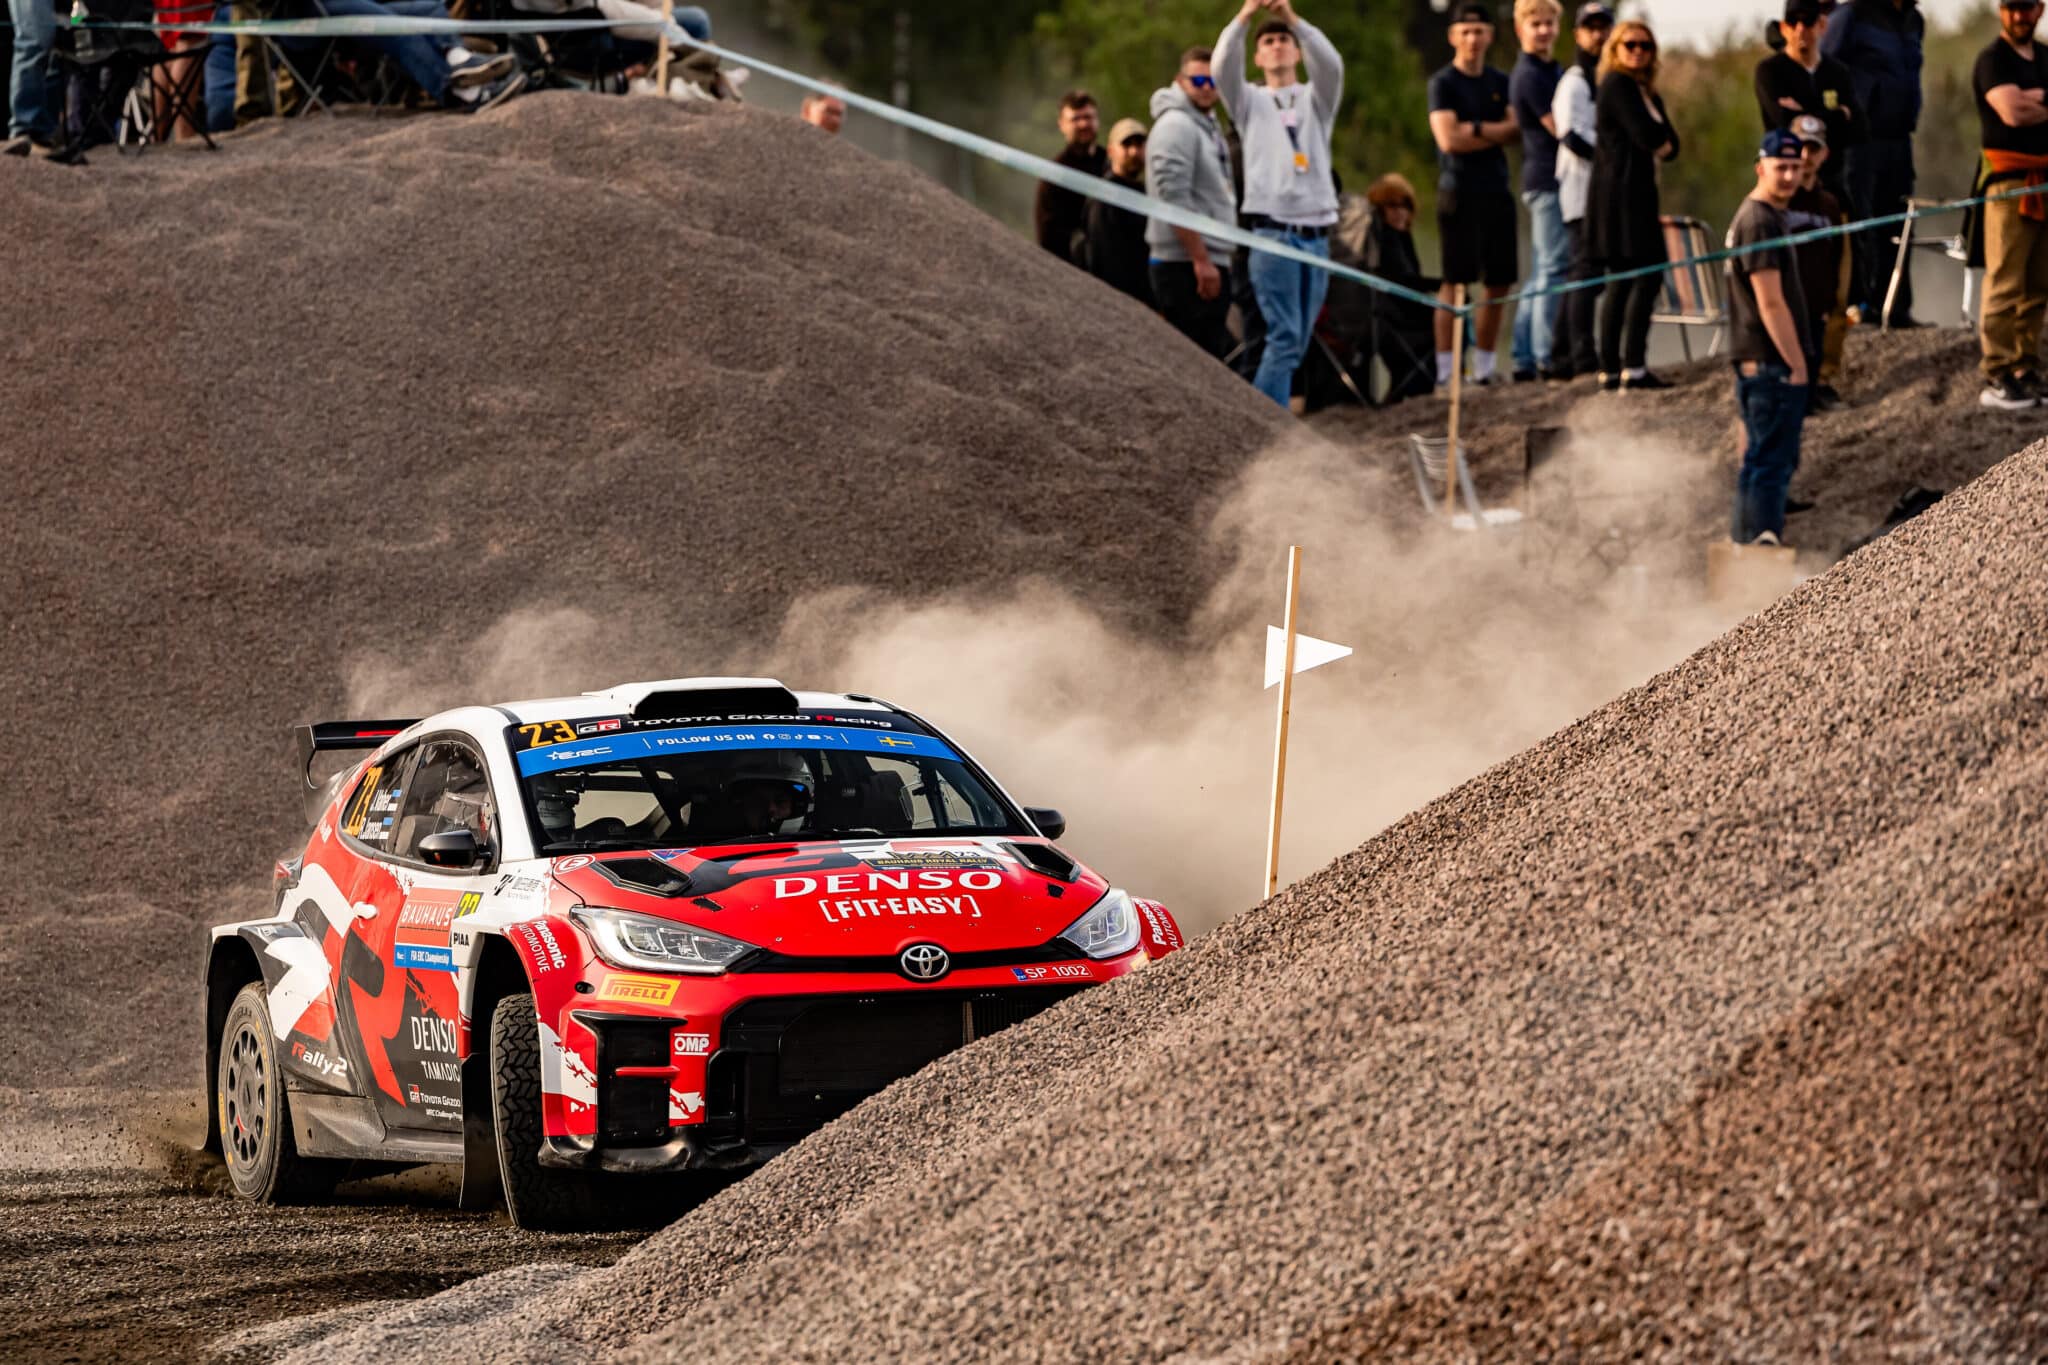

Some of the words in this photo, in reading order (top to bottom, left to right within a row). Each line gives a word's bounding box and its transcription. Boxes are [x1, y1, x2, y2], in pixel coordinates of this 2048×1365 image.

[579, 722, 621, 734] GR
[628, 714, 722, 726] TOYOTA
[816, 715, 892, 727] Racing
[519, 720, 578, 748] 23
[657, 735, 711, 746] FOLLOW
[714, 734, 734, 743] US
[736, 734, 756, 742] ON
[773, 871, 1002, 899] DENSO
[401, 904, 453, 927] BAUHAUS
[453, 932, 470, 947] PIAA
[531, 919, 567, 970] Panasonic
[1024, 967, 1047, 979] SP
[1052, 965, 1089, 977] 1002
[604, 979, 672, 1000] PIRELLI
[411, 1016, 457, 1054] DENSO
[674, 1037, 710, 1052] OMP
[291, 1041, 349, 1077] Rally2
[421, 1060, 461, 1083] TAMADIC
